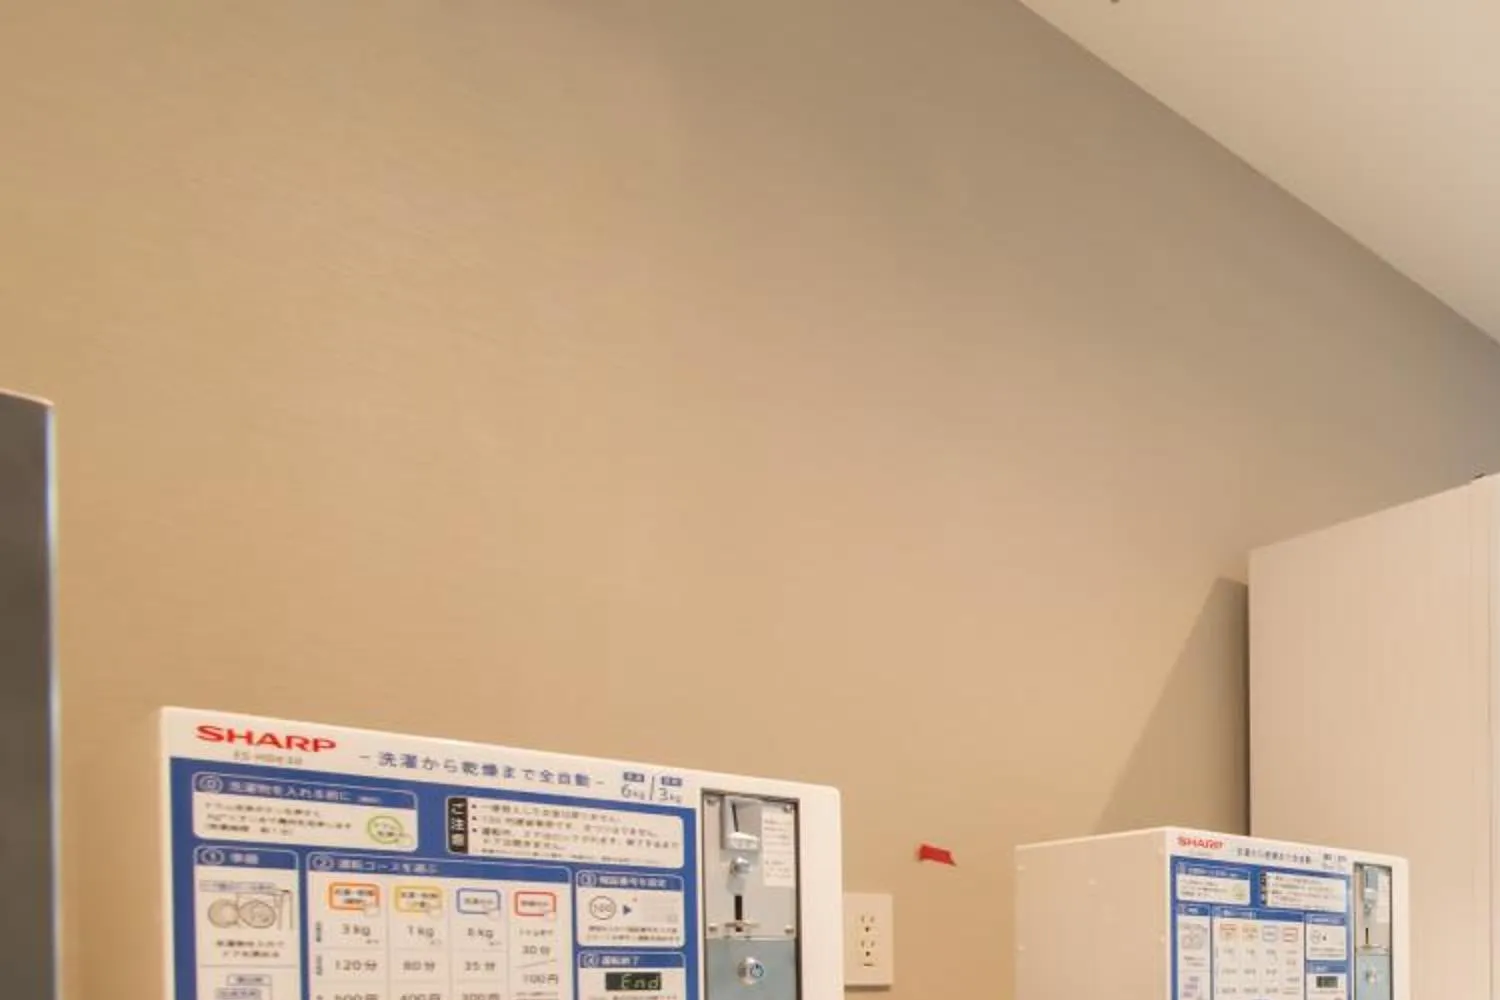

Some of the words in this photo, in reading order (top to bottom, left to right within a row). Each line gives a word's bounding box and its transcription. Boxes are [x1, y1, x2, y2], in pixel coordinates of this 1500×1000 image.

[196, 724, 337, 753] SHARP
[378, 750, 591, 788] 洗濯から乾燥まで全自動
